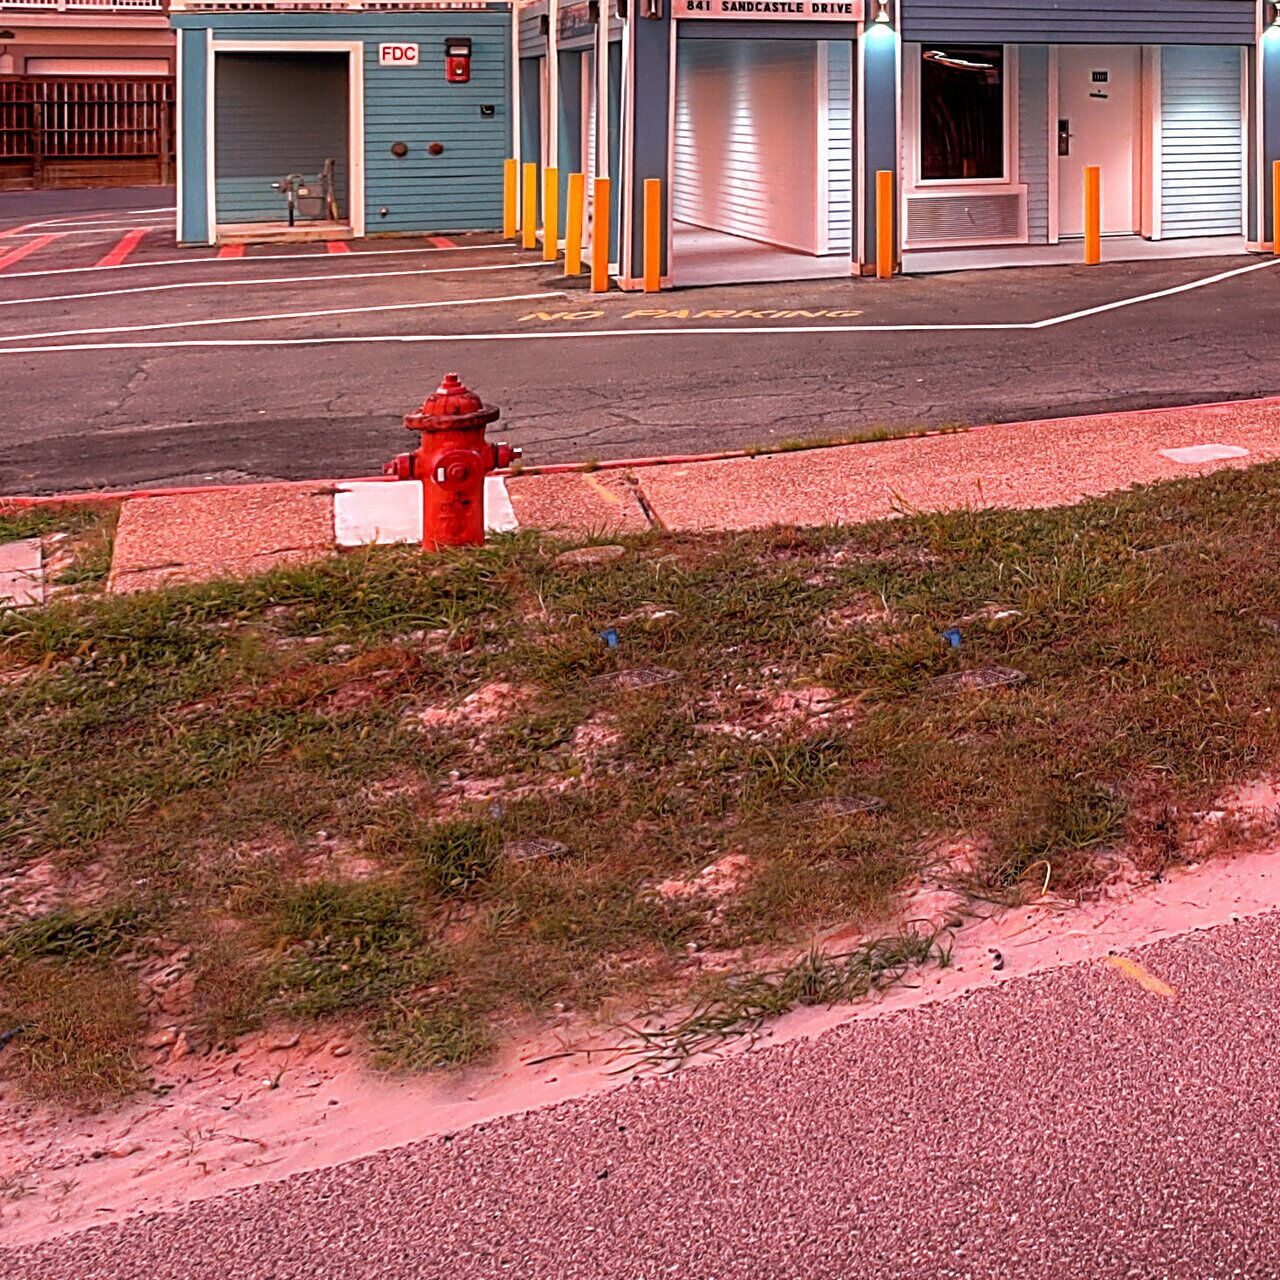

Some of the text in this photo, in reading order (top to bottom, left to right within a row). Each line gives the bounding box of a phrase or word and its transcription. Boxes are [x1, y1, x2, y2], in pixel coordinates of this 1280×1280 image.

[687, 0, 852, 14] 841 SANDCASTLE DRIVE
[382, 46, 416, 60] FDC
[518, 309, 864, 322] NO PARKING
